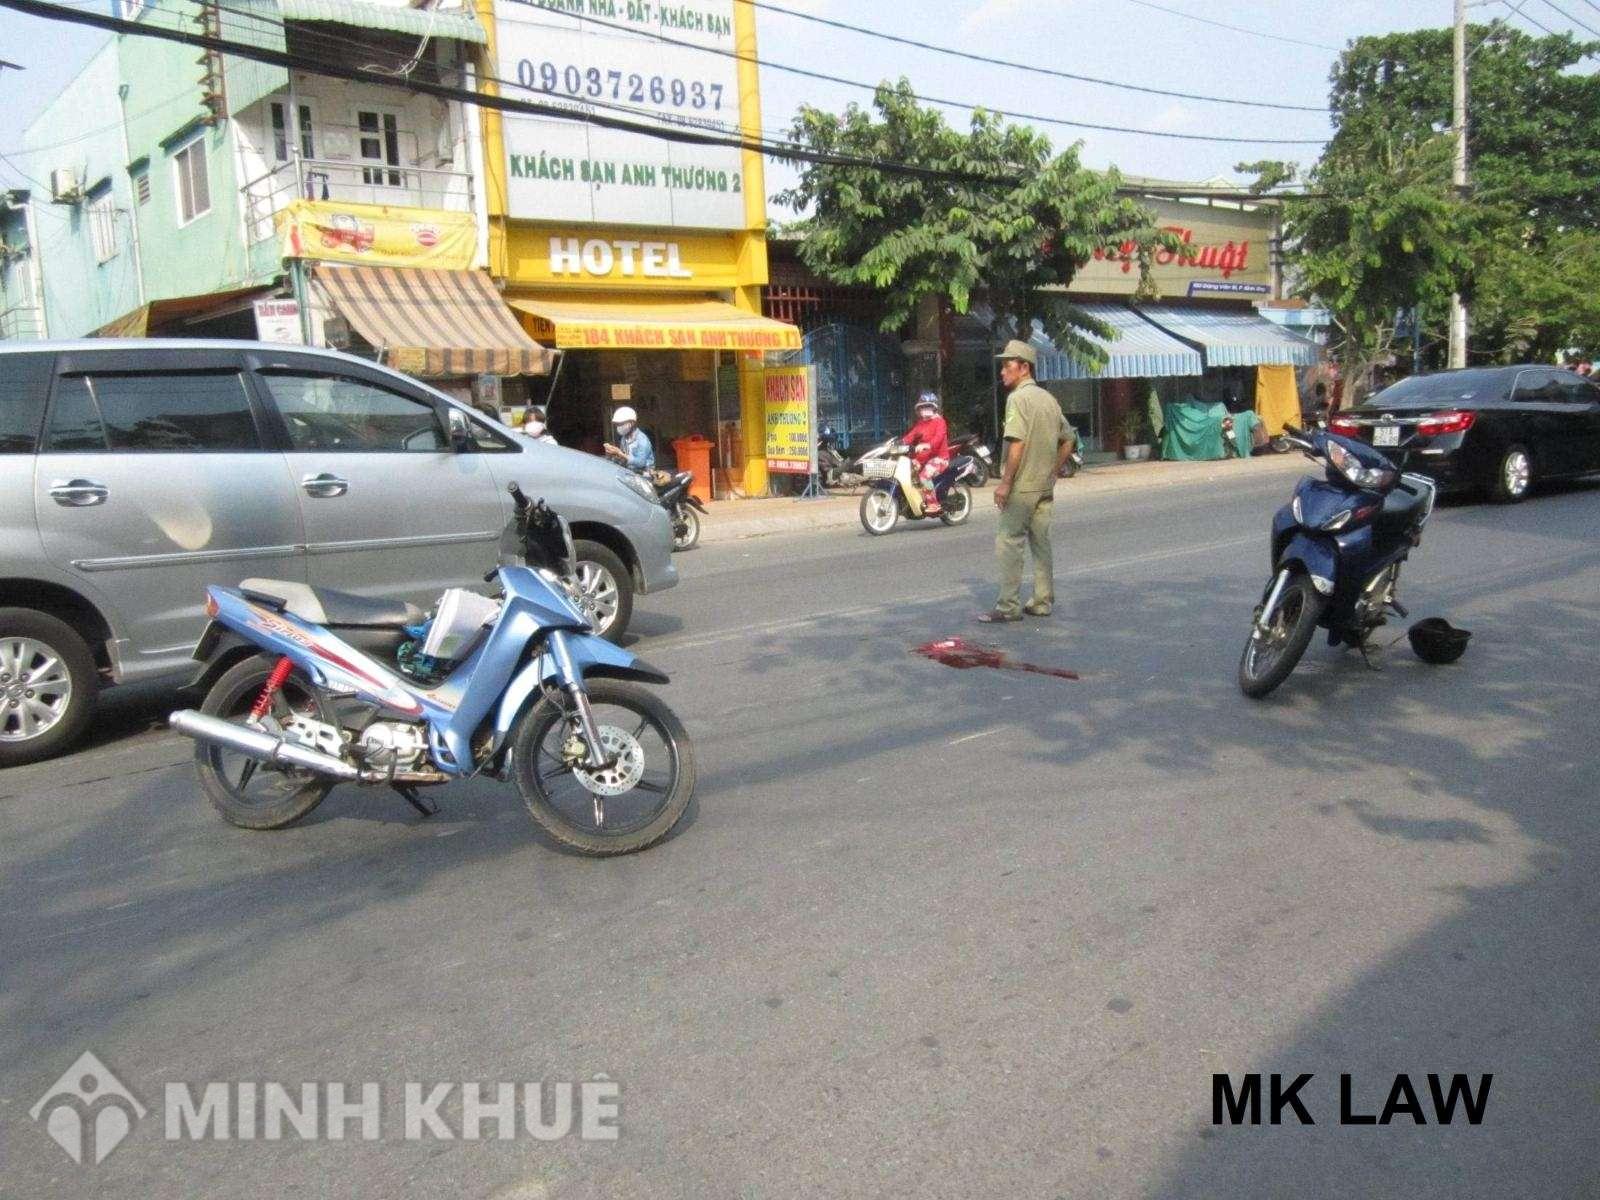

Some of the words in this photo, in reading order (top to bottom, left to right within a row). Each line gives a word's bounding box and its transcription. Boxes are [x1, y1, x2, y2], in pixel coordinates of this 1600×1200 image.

[660, 5, 704, 32] KHÁCH
[517, 58, 724, 111] 0903726937
[510, 150, 575, 181] KHÁCH
[580, 159, 616, 191] SẠN
[621, 163, 656, 187] ANH
[661, 165, 728, 192] THƯƠNG
[732, 173, 741, 193] 2
[549, 236, 693, 279] HOTEL
